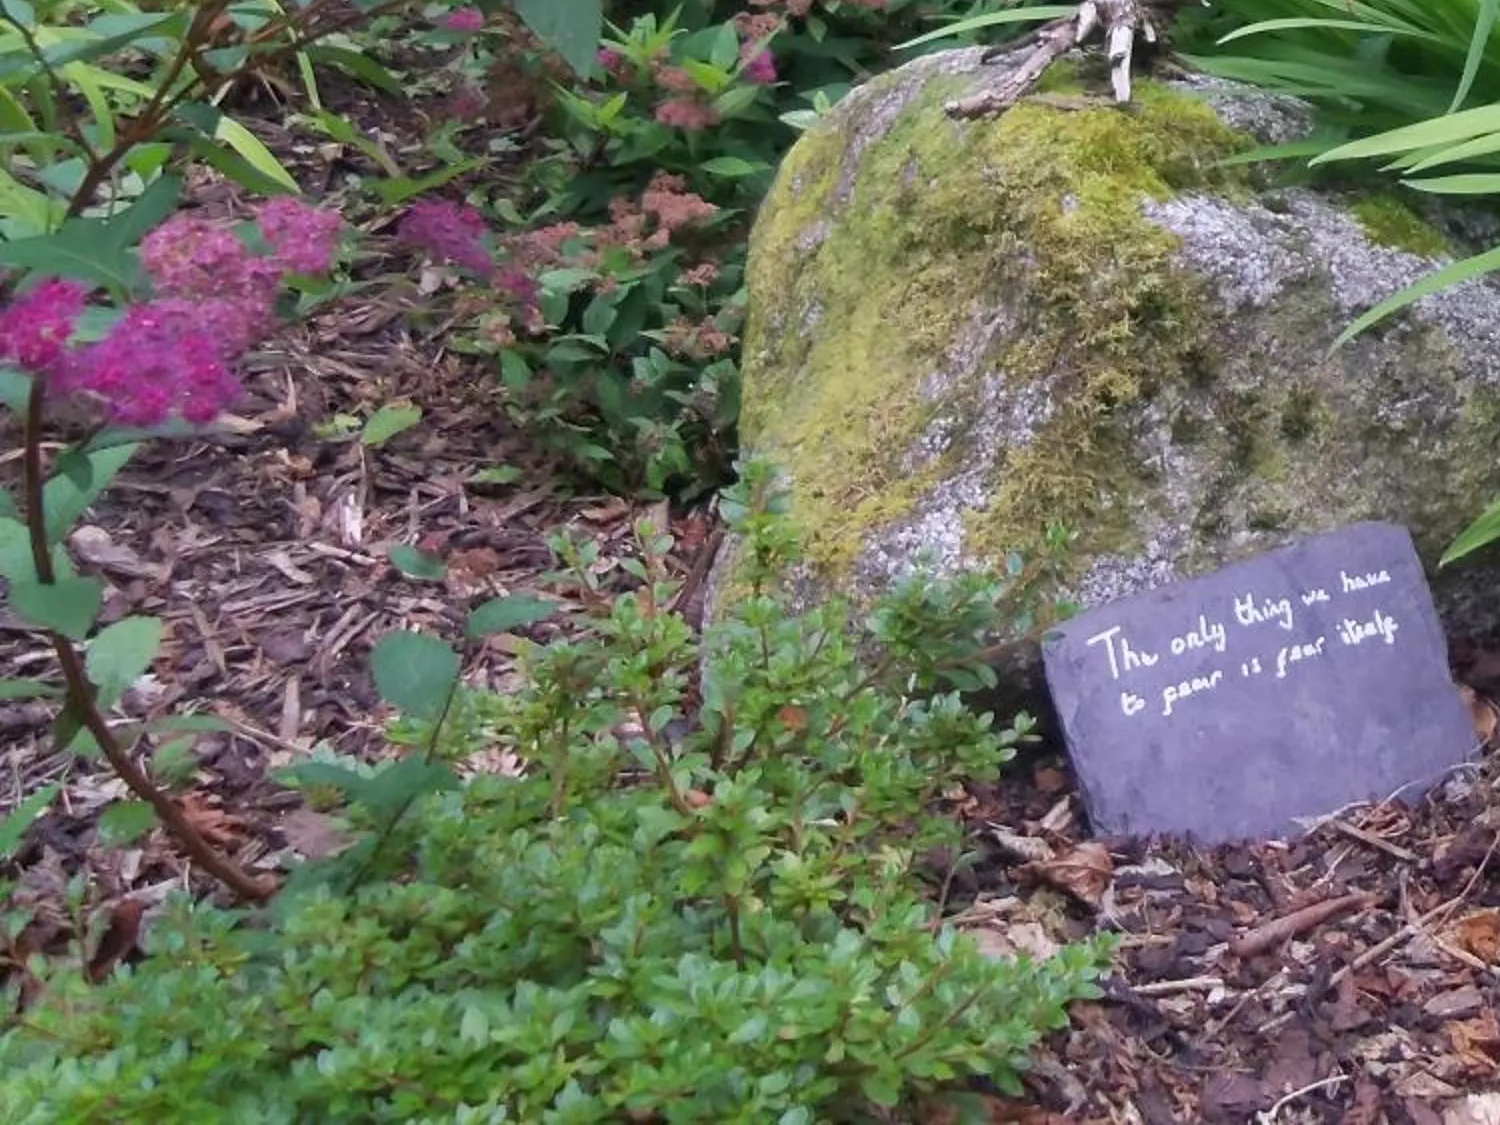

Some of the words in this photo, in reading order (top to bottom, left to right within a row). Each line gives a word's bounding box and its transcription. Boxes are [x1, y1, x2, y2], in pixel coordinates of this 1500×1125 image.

[1086, 626, 1159, 679] The
[1171, 615, 1226, 652] only
[1235, 593, 1292, 629] thing
[1301, 589, 1330, 606] we
[1340, 569, 1391, 593] have
[1121, 691, 1145, 716] to
[1162, 671, 1224, 716] fear
[1241, 658, 1262, 677] is
[1276, 636, 1325, 678] fear
[1337, 609, 1399, 644] itself
